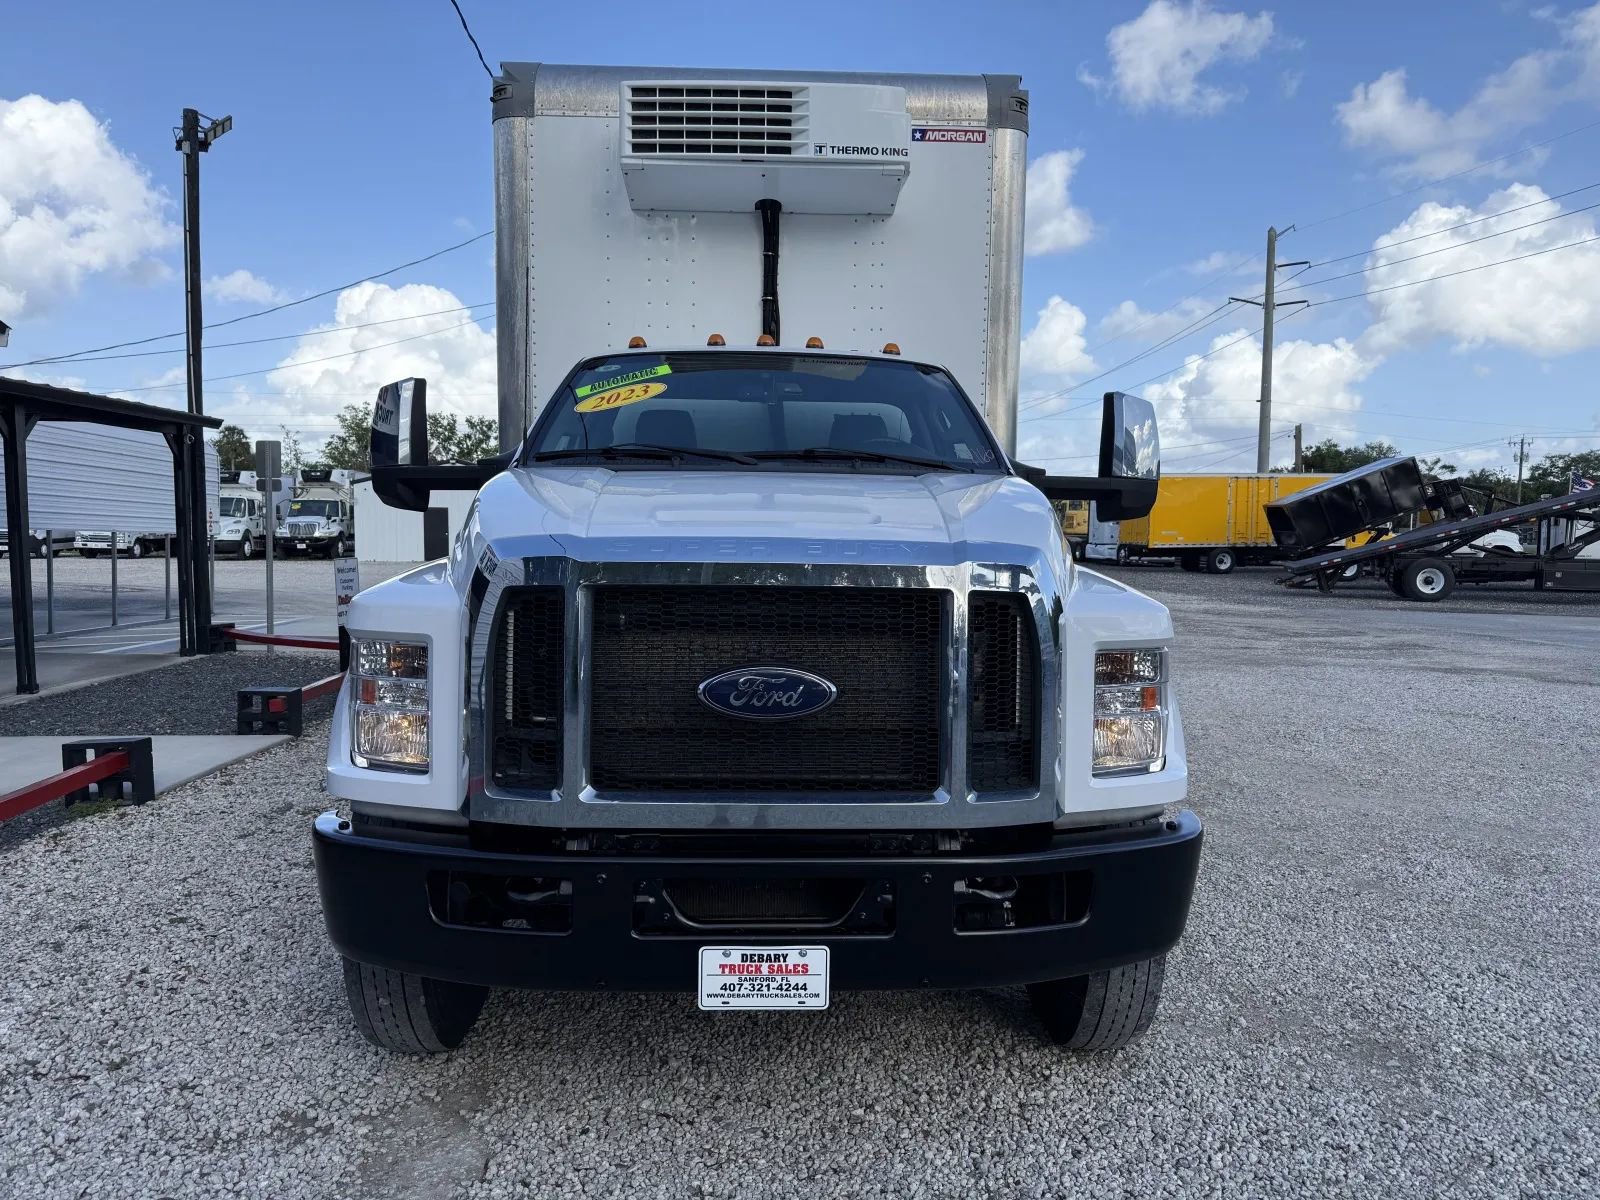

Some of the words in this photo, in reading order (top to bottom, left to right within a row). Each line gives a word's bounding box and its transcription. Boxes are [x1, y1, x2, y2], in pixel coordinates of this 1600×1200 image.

[925, 130, 984, 142] MORGAN
[829, 145, 879, 156] THERMO
[881, 147, 909, 157] KING
[590, 367, 658, 393] AUTOMATIC
[591, 384, 651, 410] 2023
[729, 675, 805, 707] Ford
[740, 953, 788, 963] DEBARY
[719, 964, 762, 974] TRUCK
[767, 963, 809, 974] SALES
[720, 983, 808, 992] 407-321-4244
